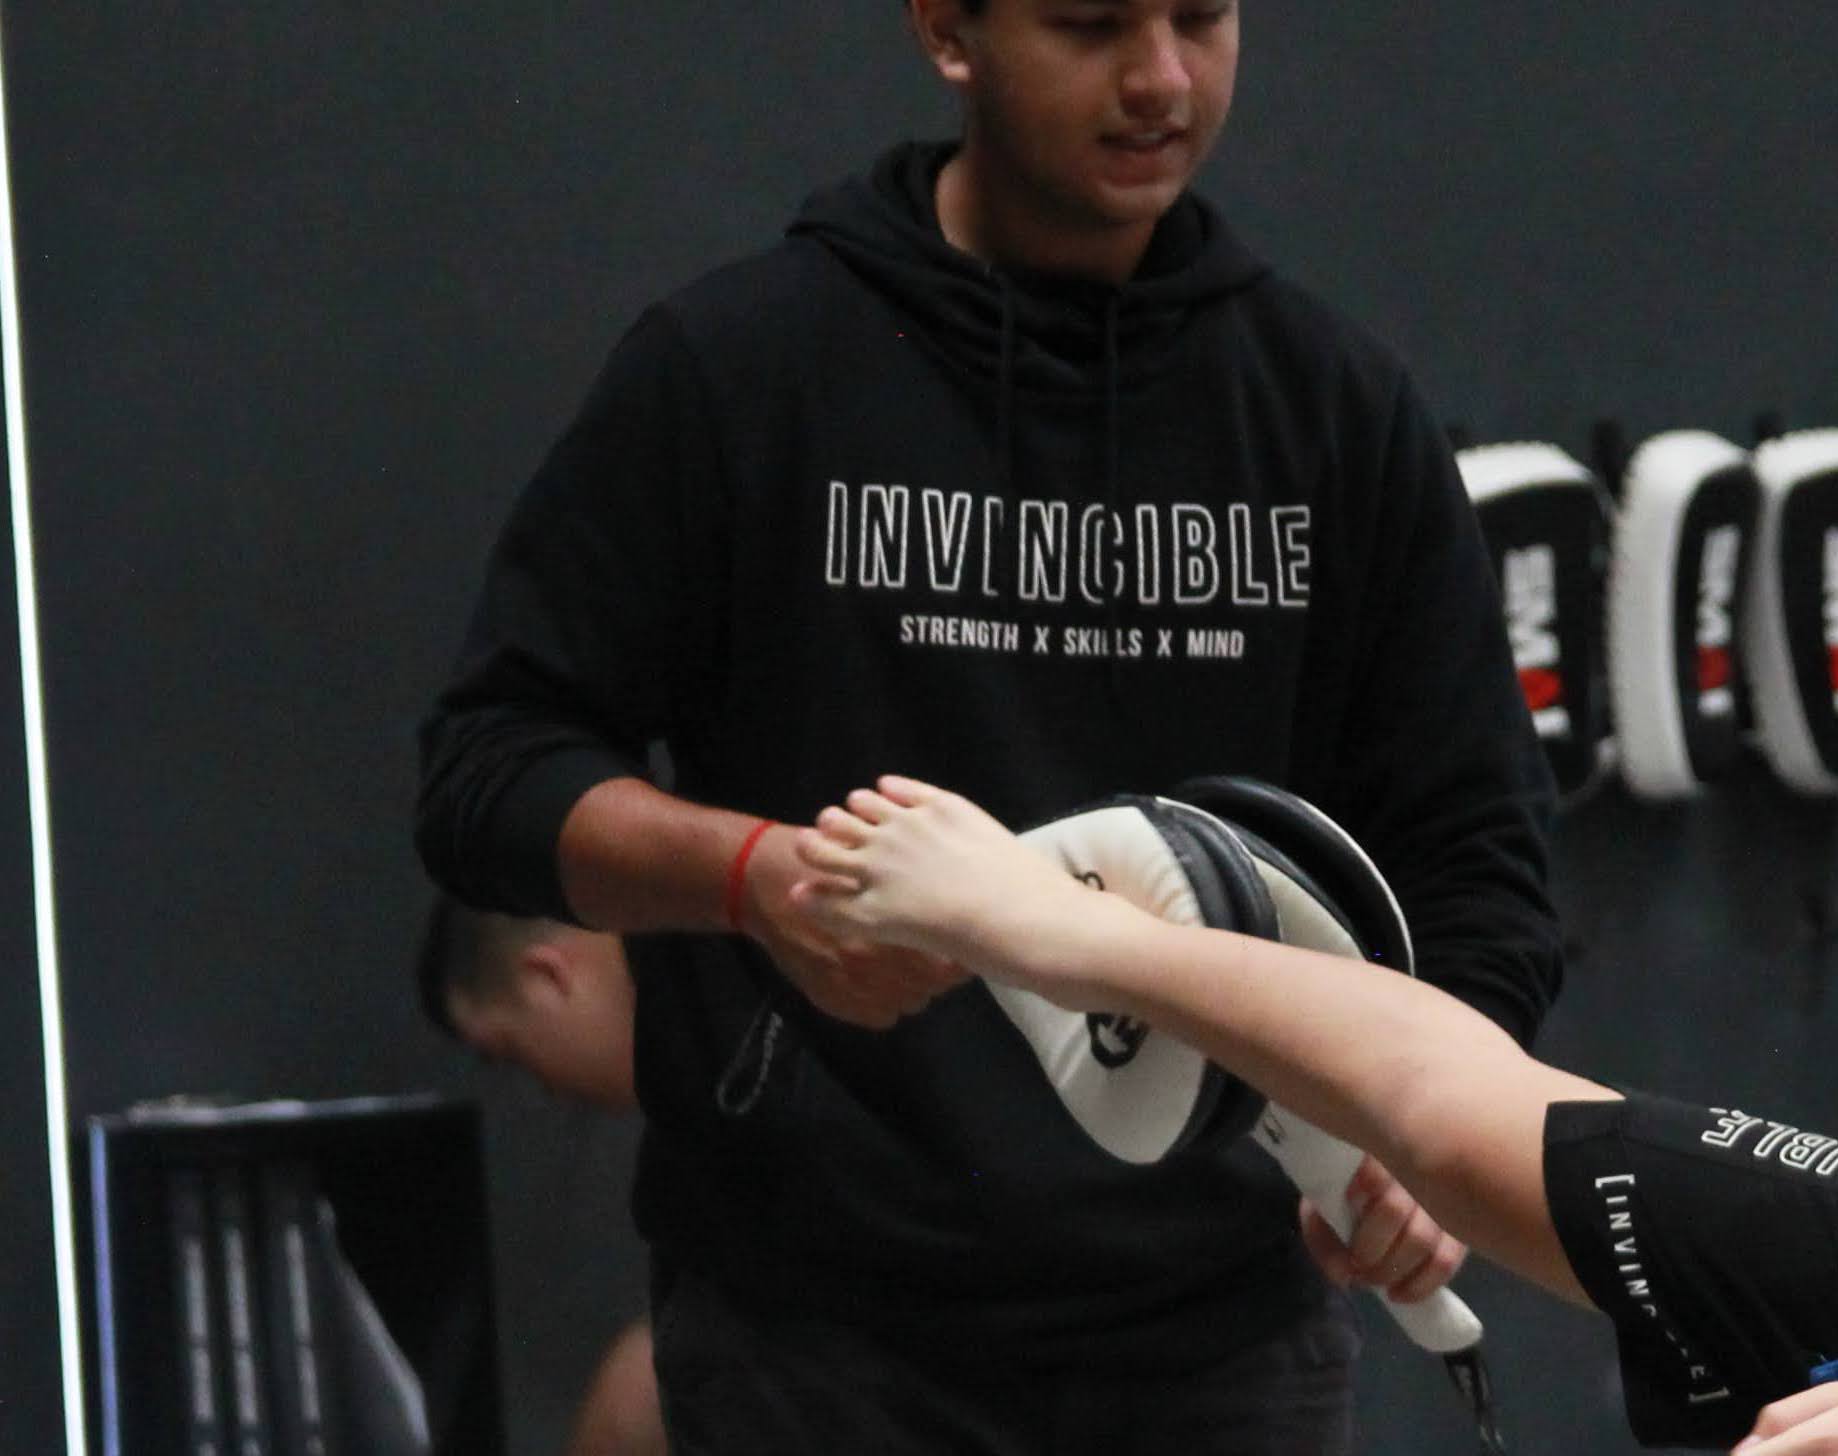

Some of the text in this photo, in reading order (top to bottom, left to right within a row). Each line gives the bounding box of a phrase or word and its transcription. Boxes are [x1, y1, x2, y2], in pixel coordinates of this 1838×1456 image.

[826, 480, 1310, 607] INVINCIBLE
[900, 614, 1245, 658] STRENGTH X SKILLS X MIND
